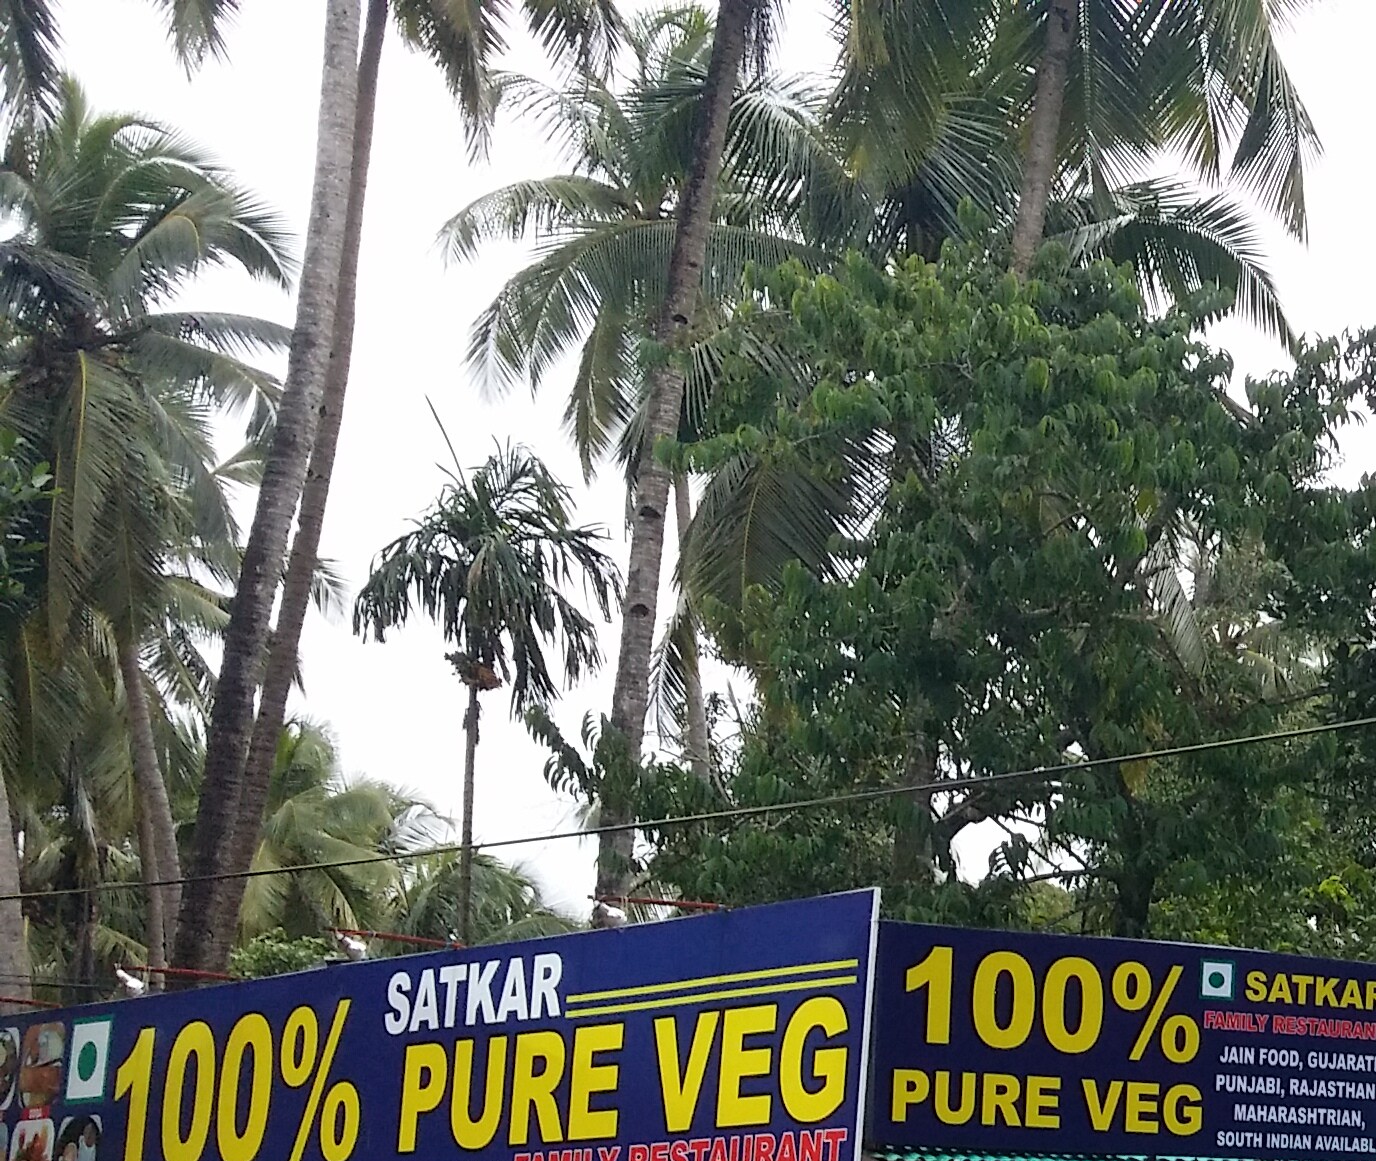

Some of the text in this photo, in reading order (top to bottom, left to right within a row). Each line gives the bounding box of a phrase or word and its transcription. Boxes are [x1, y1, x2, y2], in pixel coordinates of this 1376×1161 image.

[385, 953, 563, 1035] SATKAR
[905, 946, 1200, 1064] 100%
[1203, 1010, 1270, 1032] FAMILY
[1219, 1046, 1255, 1064] JAIN
[1258, 1047, 1303, 1071] FOOD,
[397, 996, 849, 1153] PURE VEG
[1215, 1074, 1285, 1098] PUNJABI,
[891, 1068, 1203, 1136] PURE VEG
[1234, 1104, 1366, 1131] MAHARASHTRIAN,
[1216, 1131, 1262, 1148] SOUTH
[1266, 1133, 1312, 1150] INDIAN
